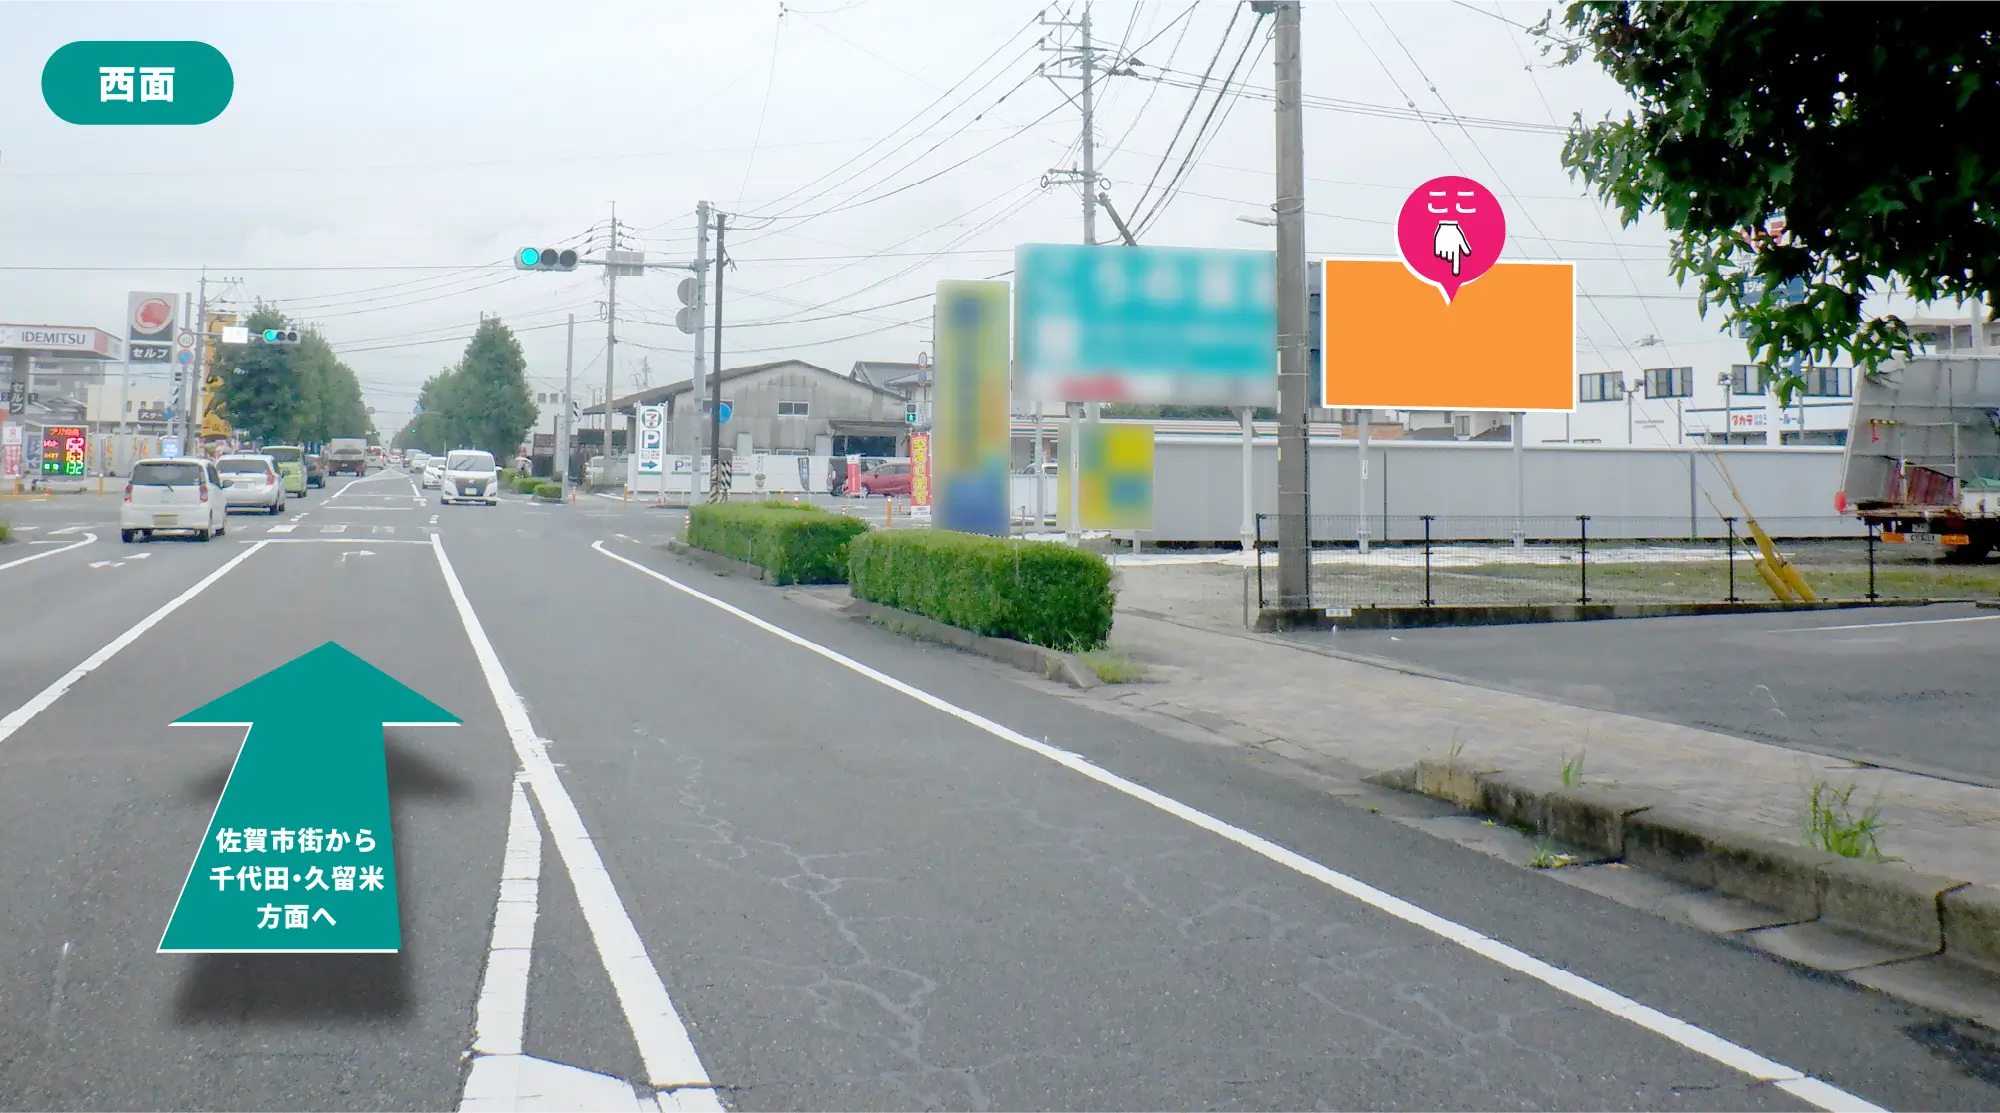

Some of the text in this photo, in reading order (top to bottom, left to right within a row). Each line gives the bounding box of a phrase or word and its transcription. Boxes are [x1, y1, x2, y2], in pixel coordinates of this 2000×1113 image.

[21, 330, 86, 345] IDEMITSU
[132, 347, 169, 359] セルフ
[11, 382, 24, 413] セルフ
[65, 437, 85, 451] 152
[643, 430, 661, 449] P
[65, 450, 84, 463] 163
[65, 461, 84, 475] 132
